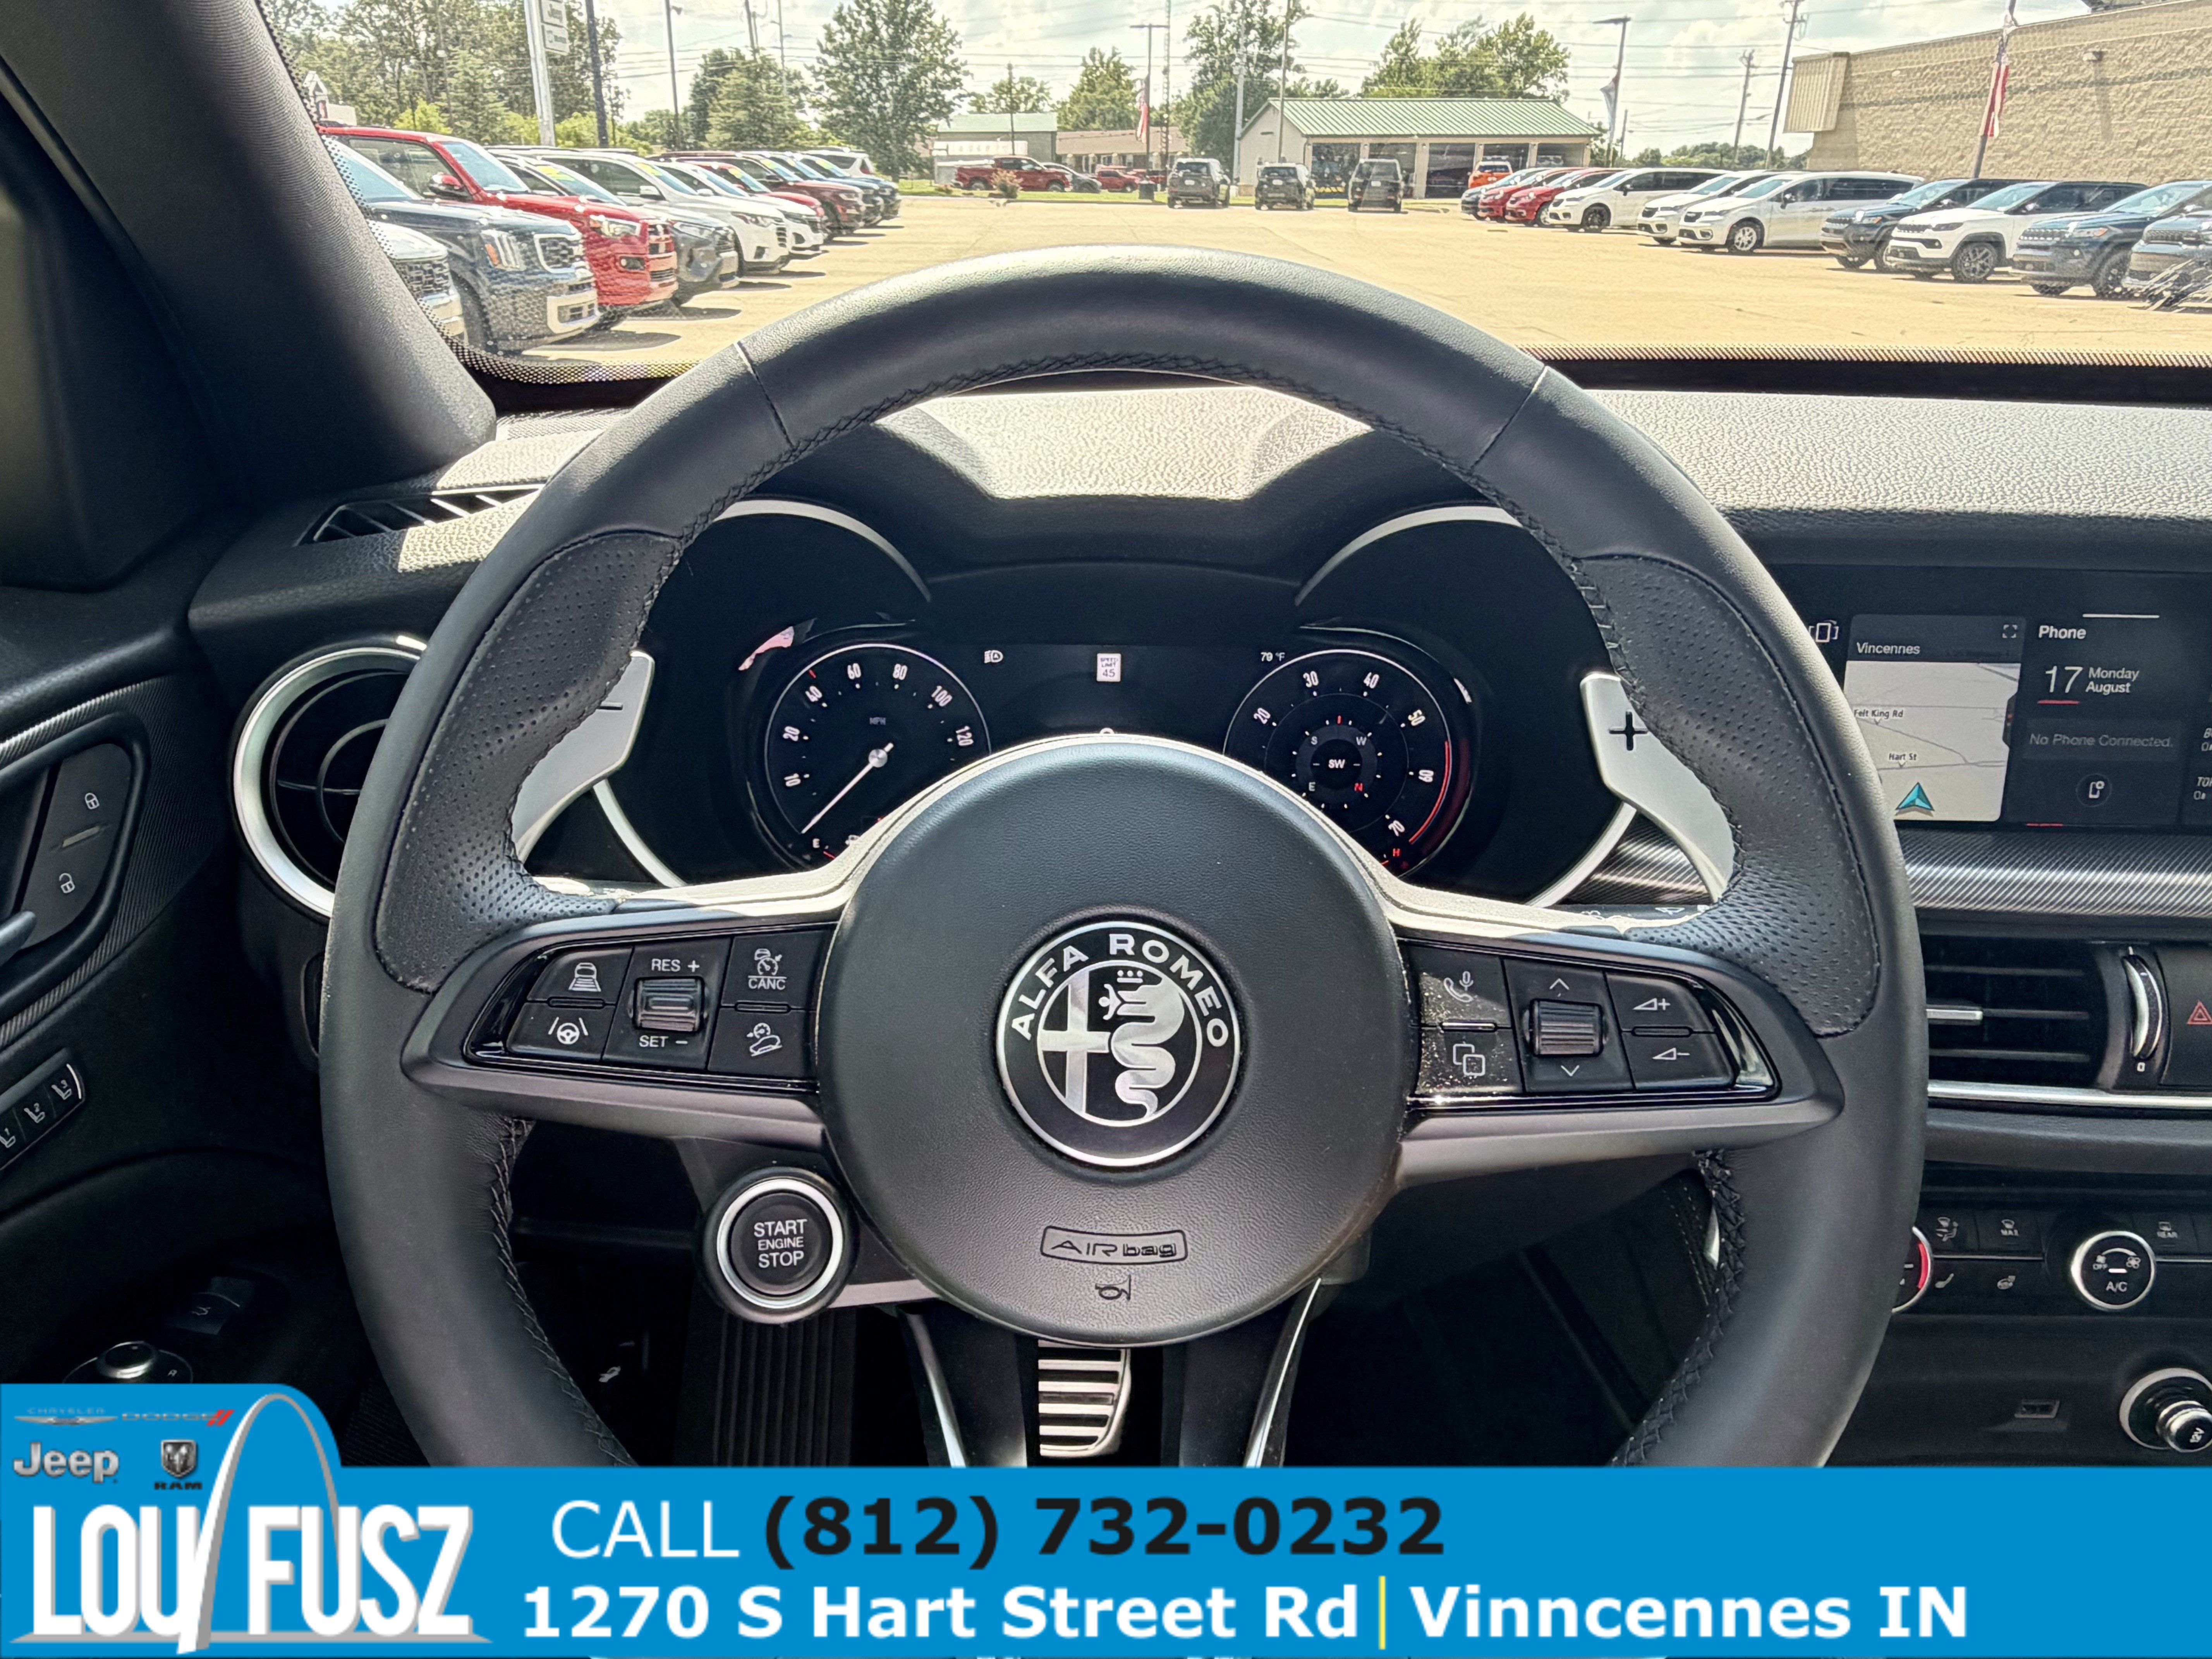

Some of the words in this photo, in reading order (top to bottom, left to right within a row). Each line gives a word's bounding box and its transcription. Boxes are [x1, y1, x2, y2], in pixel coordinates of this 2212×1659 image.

[2039, 625, 2086, 639] Phone
[1857, 642, 1921, 654] Vincennes
[847, 663, 861, 679] 60
[893, 663, 907, 680] 80
[1103, 669, 1115, 677] 45
[1303, 671, 1319, 687] 30
[1363, 672, 1379, 689] 40
[2045, 665, 2083, 693] 17
[2088, 667, 2140, 681] Monday
[805, 685, 823, 702] 40
[931, 685, 953, 703] 100
[2085, 682, 2131, 695] August
[869, 717, 886, 725] MPH
[1254, 708, 1271, 724] 20
[1408, 709, 1426, 726] 50
[1854, 709, 1869, 717] Felt
[1871, 710, 1889, 719] King
[783, 726, 800, 742] 20
[955, 726, 974, 746] 120
[1311, 736, 1317, 745] S
[2029, 734, 2049, 745] No
[2053, 734, 2095, 746] Phone
[2099, 735, 2173, 748] Connected.
[1356, 737, 1367, 746] W
[1329, 759, 1346, 769] SW
[784, 773, 801, 787] 10
[1419, 769, 1434, 783] 60
[1309, 782, 1316, 791] E
[1354, 783, 1363, 792] N
[1388, 820, 1405, 836] 70
[1393, 848, 1401, 856] H
[651, 959, 681, 972] RES
[748, 978, 786, 991] CANC
[1012, 945, 1089, 1041] ALFA
[1109, 933, 1229, 1047] ROMEO
[639, 1035, 668, 1048] SET
[754, 1219, 808, 1238] START
[757, 1237, 804, 1251] ENGINE
[758, 1251, 804, 1269] STOP
[2106, 1281, 2128, 1293] A/C
